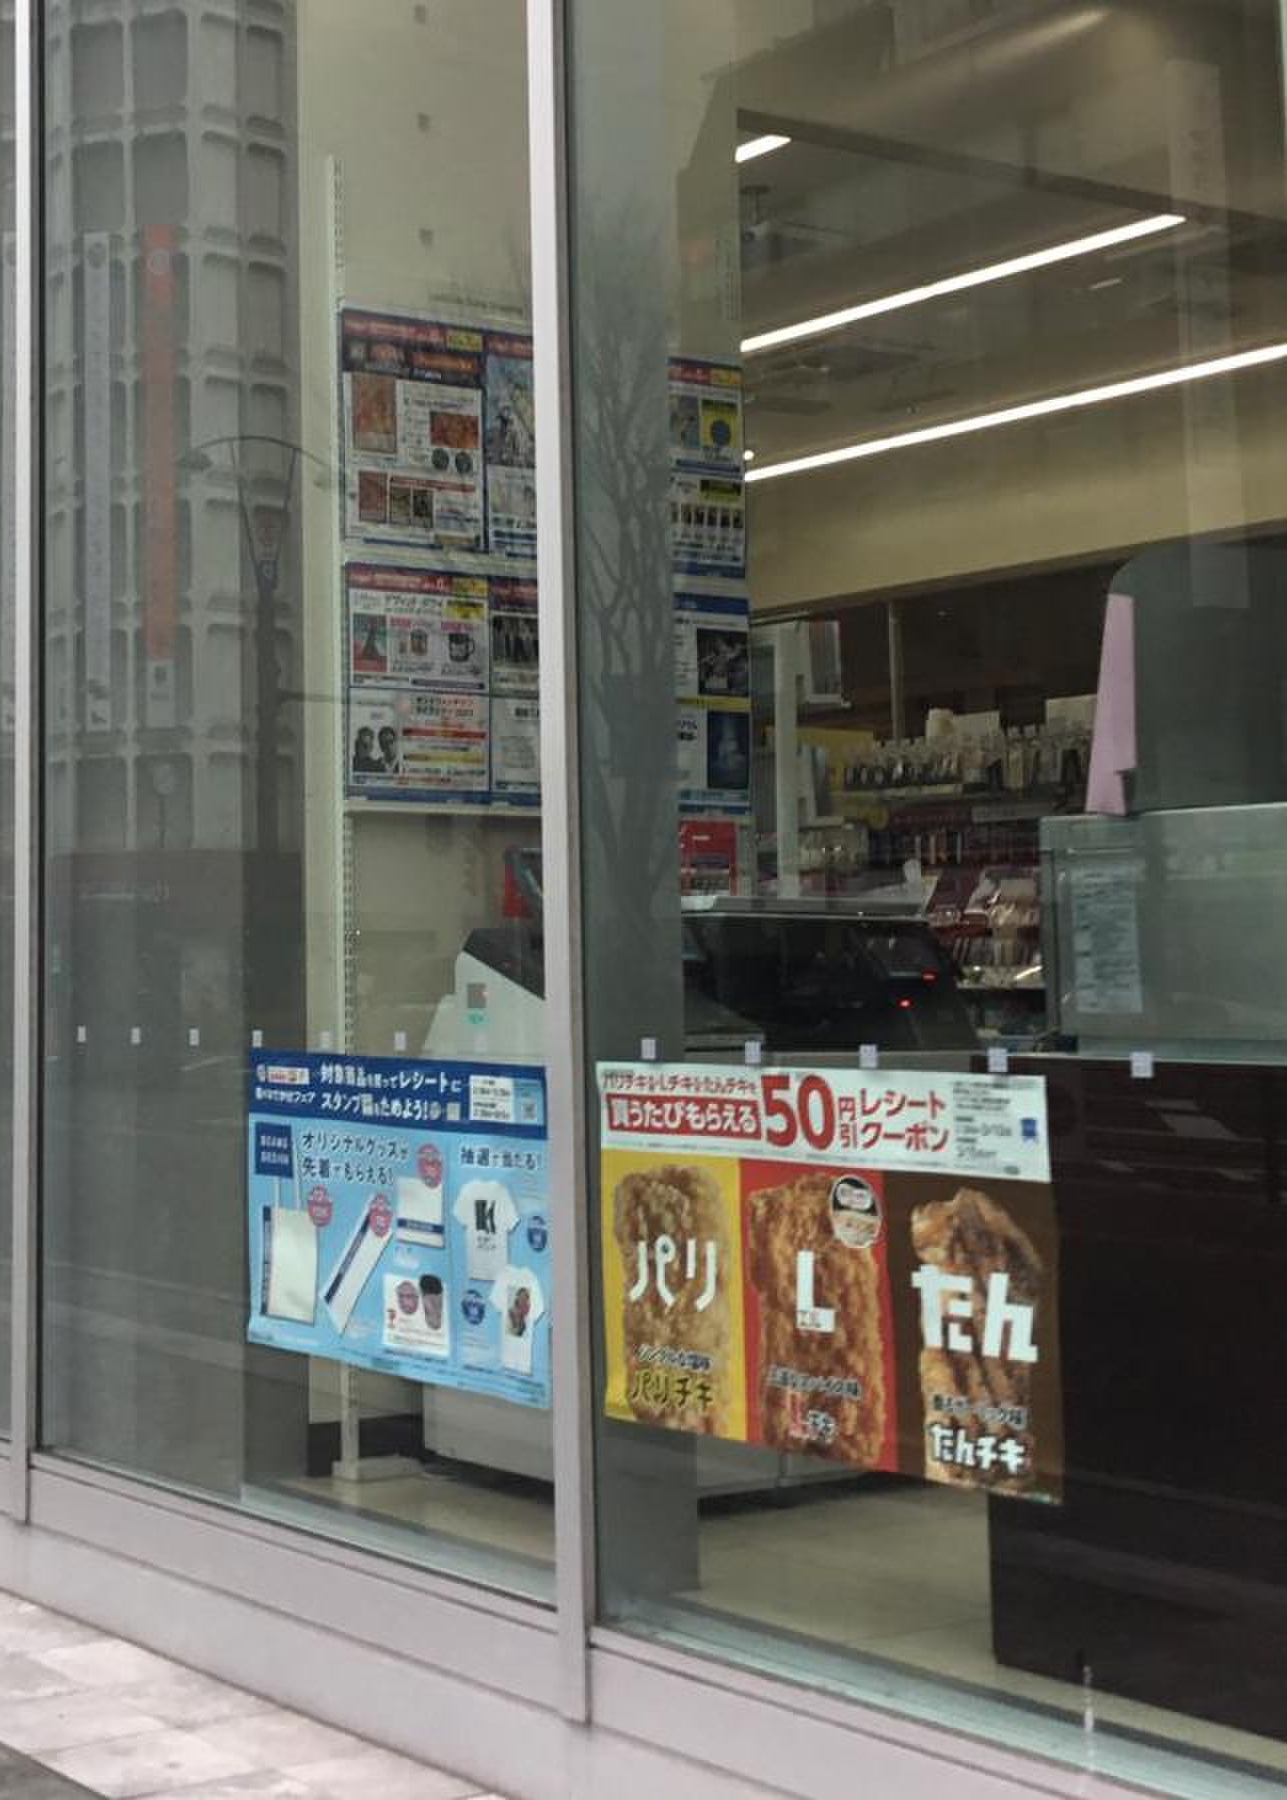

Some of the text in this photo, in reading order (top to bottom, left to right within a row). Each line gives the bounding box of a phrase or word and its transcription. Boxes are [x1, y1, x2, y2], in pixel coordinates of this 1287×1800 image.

[611, 1098, 758, 1135] 買うたびもらえる
[760, 1074, 834, 1150] 50
[861, 1088, 946, 1117] レシート
[861, 1120, 949, 1152] クーポン
[629, 1234, 717, 1312] パリ
[796, 1249, 835, 1332] L
[912, 1263, 1039, 1363] たん
[929, 1423, 1027, 1475] たんチキ
